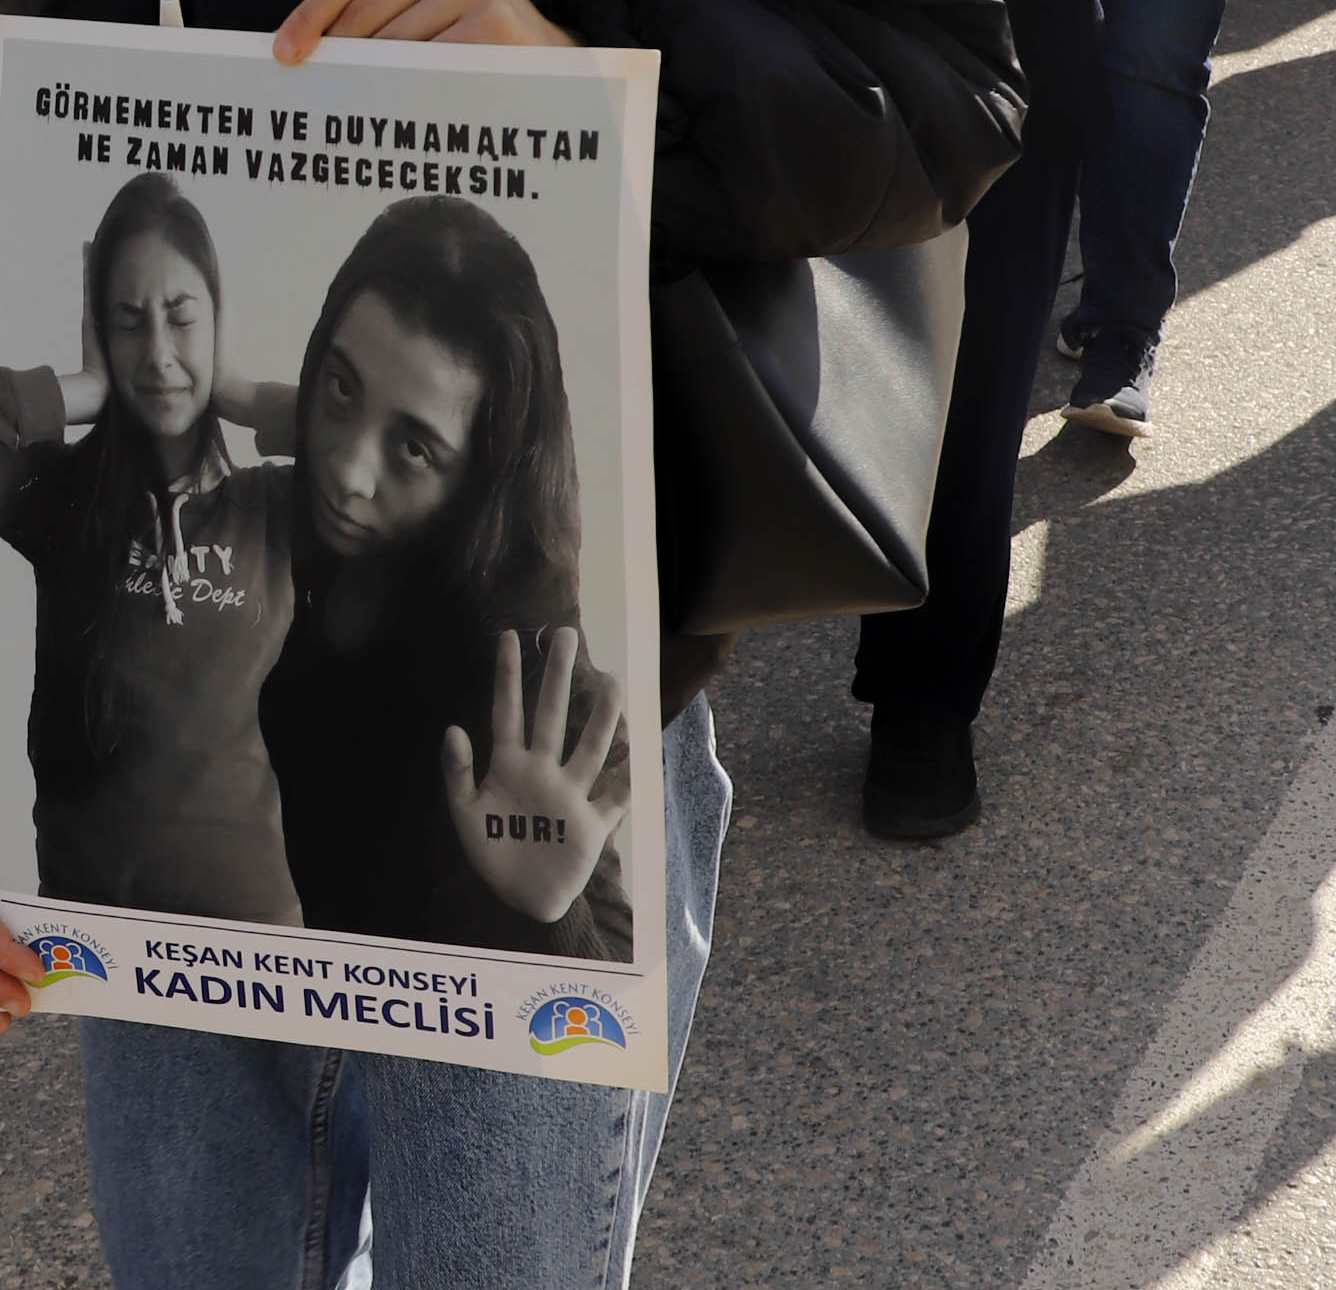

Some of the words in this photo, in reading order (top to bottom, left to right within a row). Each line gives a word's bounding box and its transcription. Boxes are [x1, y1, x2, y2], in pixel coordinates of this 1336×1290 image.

[36, 83, 253, 137] GÖRMEMEKTEN
[270, 110, 308, 141] VE
[325, 114, 599, 161] DUYMAMAKTAN
[78, 133, 111, 163] NE
[127, 136, 229, 175] ZAMAN
[190, 578, 246, 611] Dept
[485, 814, 566, 844] DUR!
[146, 940, 242, 968] KEŞAN
[254, 952, 334, 979] KENT
[344, 963, 477, 997] KONSEYİ
[550, 983, 588, 995] KENT
[135, 966, 285, 1013] KADIN
[303, 988, 495, 1040] MECLİSİ
